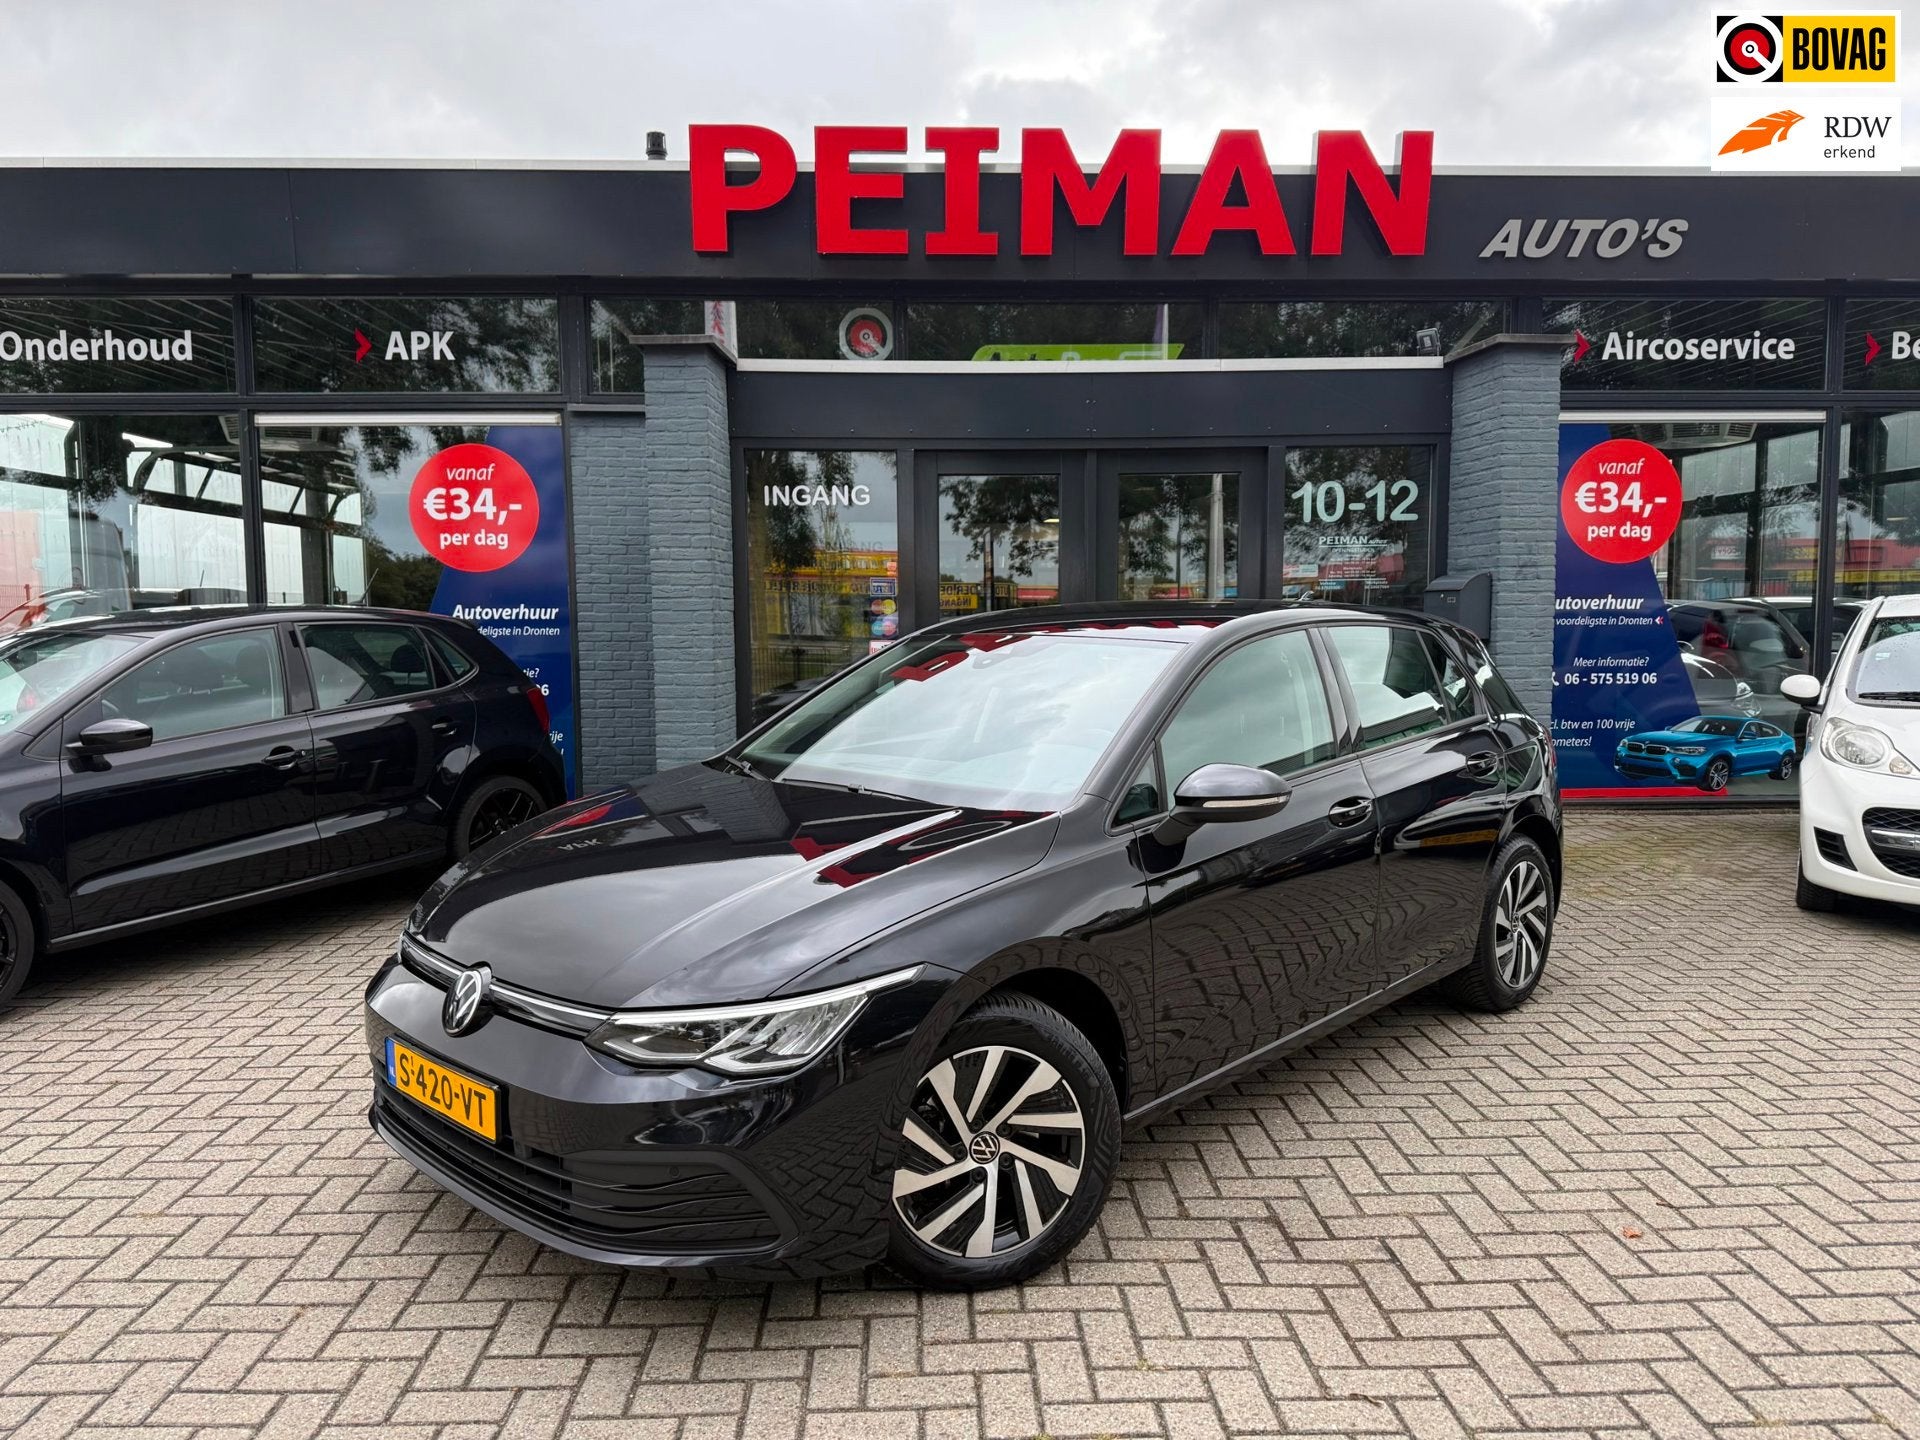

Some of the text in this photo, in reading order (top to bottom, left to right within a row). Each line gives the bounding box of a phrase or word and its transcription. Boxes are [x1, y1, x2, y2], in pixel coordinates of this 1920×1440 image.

[688, 123, 1434, 257] PEIMAN
[1478, 218, 1689, 259] AUTO'S
[0, 329, 194, 362] Onderhoud
[385, 330, 456, 361] APK
[1602, 330, 1796, 361] Aircoservice
[446, 463, 497, 481] vanaf
[1598, 457, 1646, 475] vanaf
[763, 484, 871, 507] INGANG
[1291, 479, 1419, 523] 10-12
[1574, 481, 1668, 518] €34,-
[422, 487, 523, 526] €34,-
[439, 528, 509, 550] per dag
[1319, 535, 1368, 545] PEIMAN
[1587, 521, 1652, 542] per dag
[452, 603, 560, 620] Autoverhuur
[1555, 594, 1644, 610] utoverhuur
[477, 625, 560, 638] deligste in Dronten
[1556, 616, 1653, 628] voordeligste in Dronten
[1573, 656, 1650, 667] Meer informatie?
[1564, 673, 1580, 685] 06
[1590, 672, 1613, 685] 575
[1616, 672, 1639, 684] 519
[1641, 672, 1657, 684] 06
[1561, 719, 1581, 730] btw
[1582, 721, 1594, 730] en
[1596, 719, 1614, 729] 100
[1615, 719, 1636, 732] vrije
[1551, 736, 1593, 747] ometers!
[399, 1052, 487, 1128] S-420-VT
